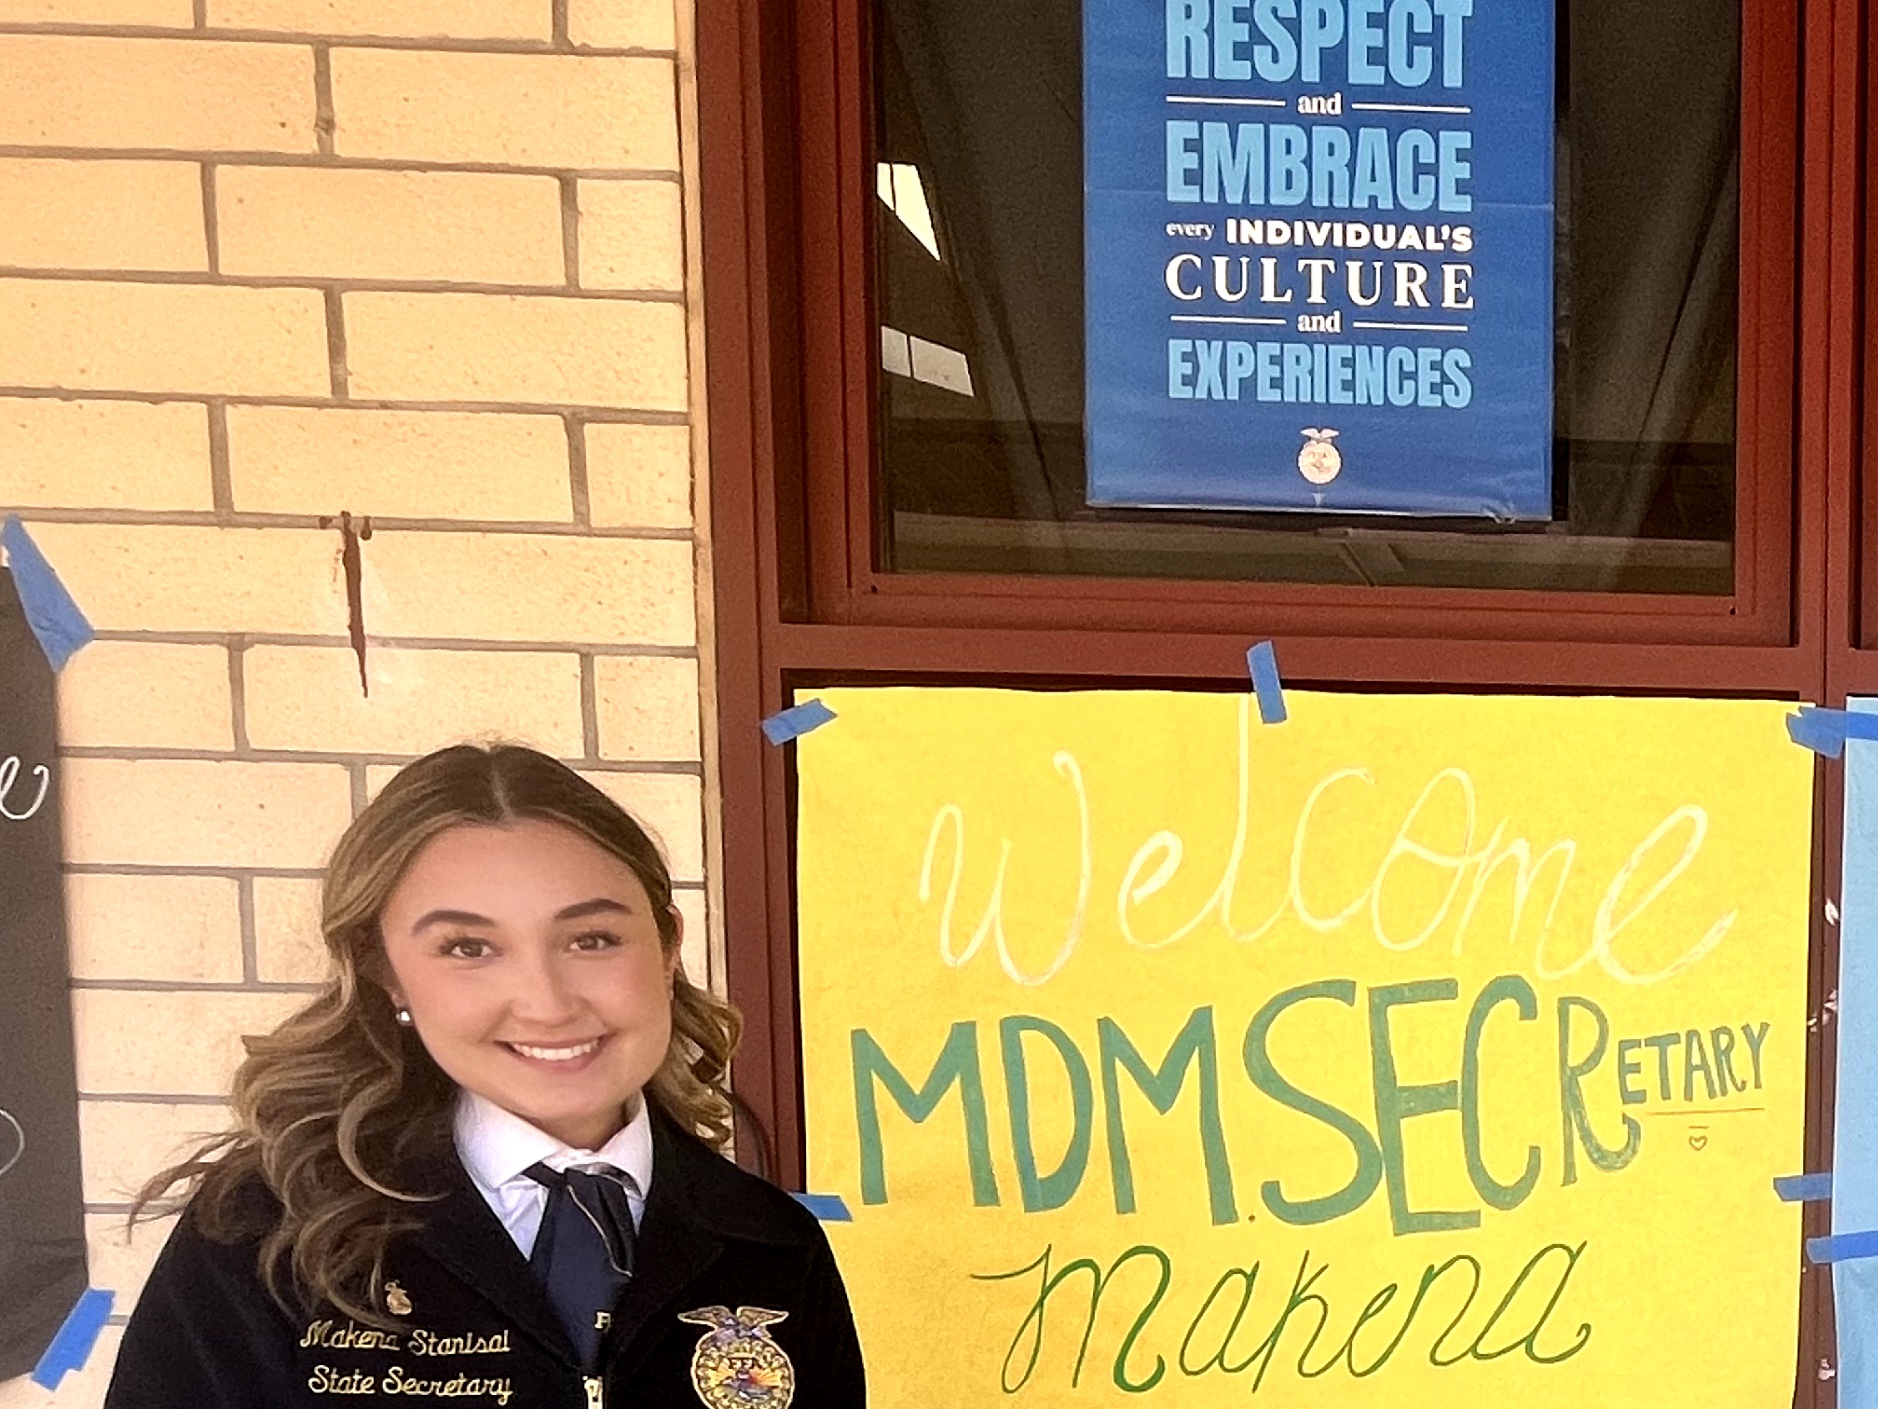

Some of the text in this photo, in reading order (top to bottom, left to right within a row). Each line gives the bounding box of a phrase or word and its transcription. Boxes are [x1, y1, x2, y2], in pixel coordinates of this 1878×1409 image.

[1165, 0, 1473, 88] RESPECT
[1297, 93, 1342, 115] and
[1165, 120, 1473, 212] EMBRACE
[1166, 218, 1473, 252] every INDIVIDUAL'S
[1165, 253, 1474, 309] CULTURE
[1297, 311, 1341, 333] and
[1168, 339, 1473, 408] EXPERIENCES
[919, 697, 1738, 986] Welcome
[300, 1320, 400, 1350] Makena
[971, 1242, 1593, 1395] Makena
[308, 1365, 514, 1406] State Secretary
